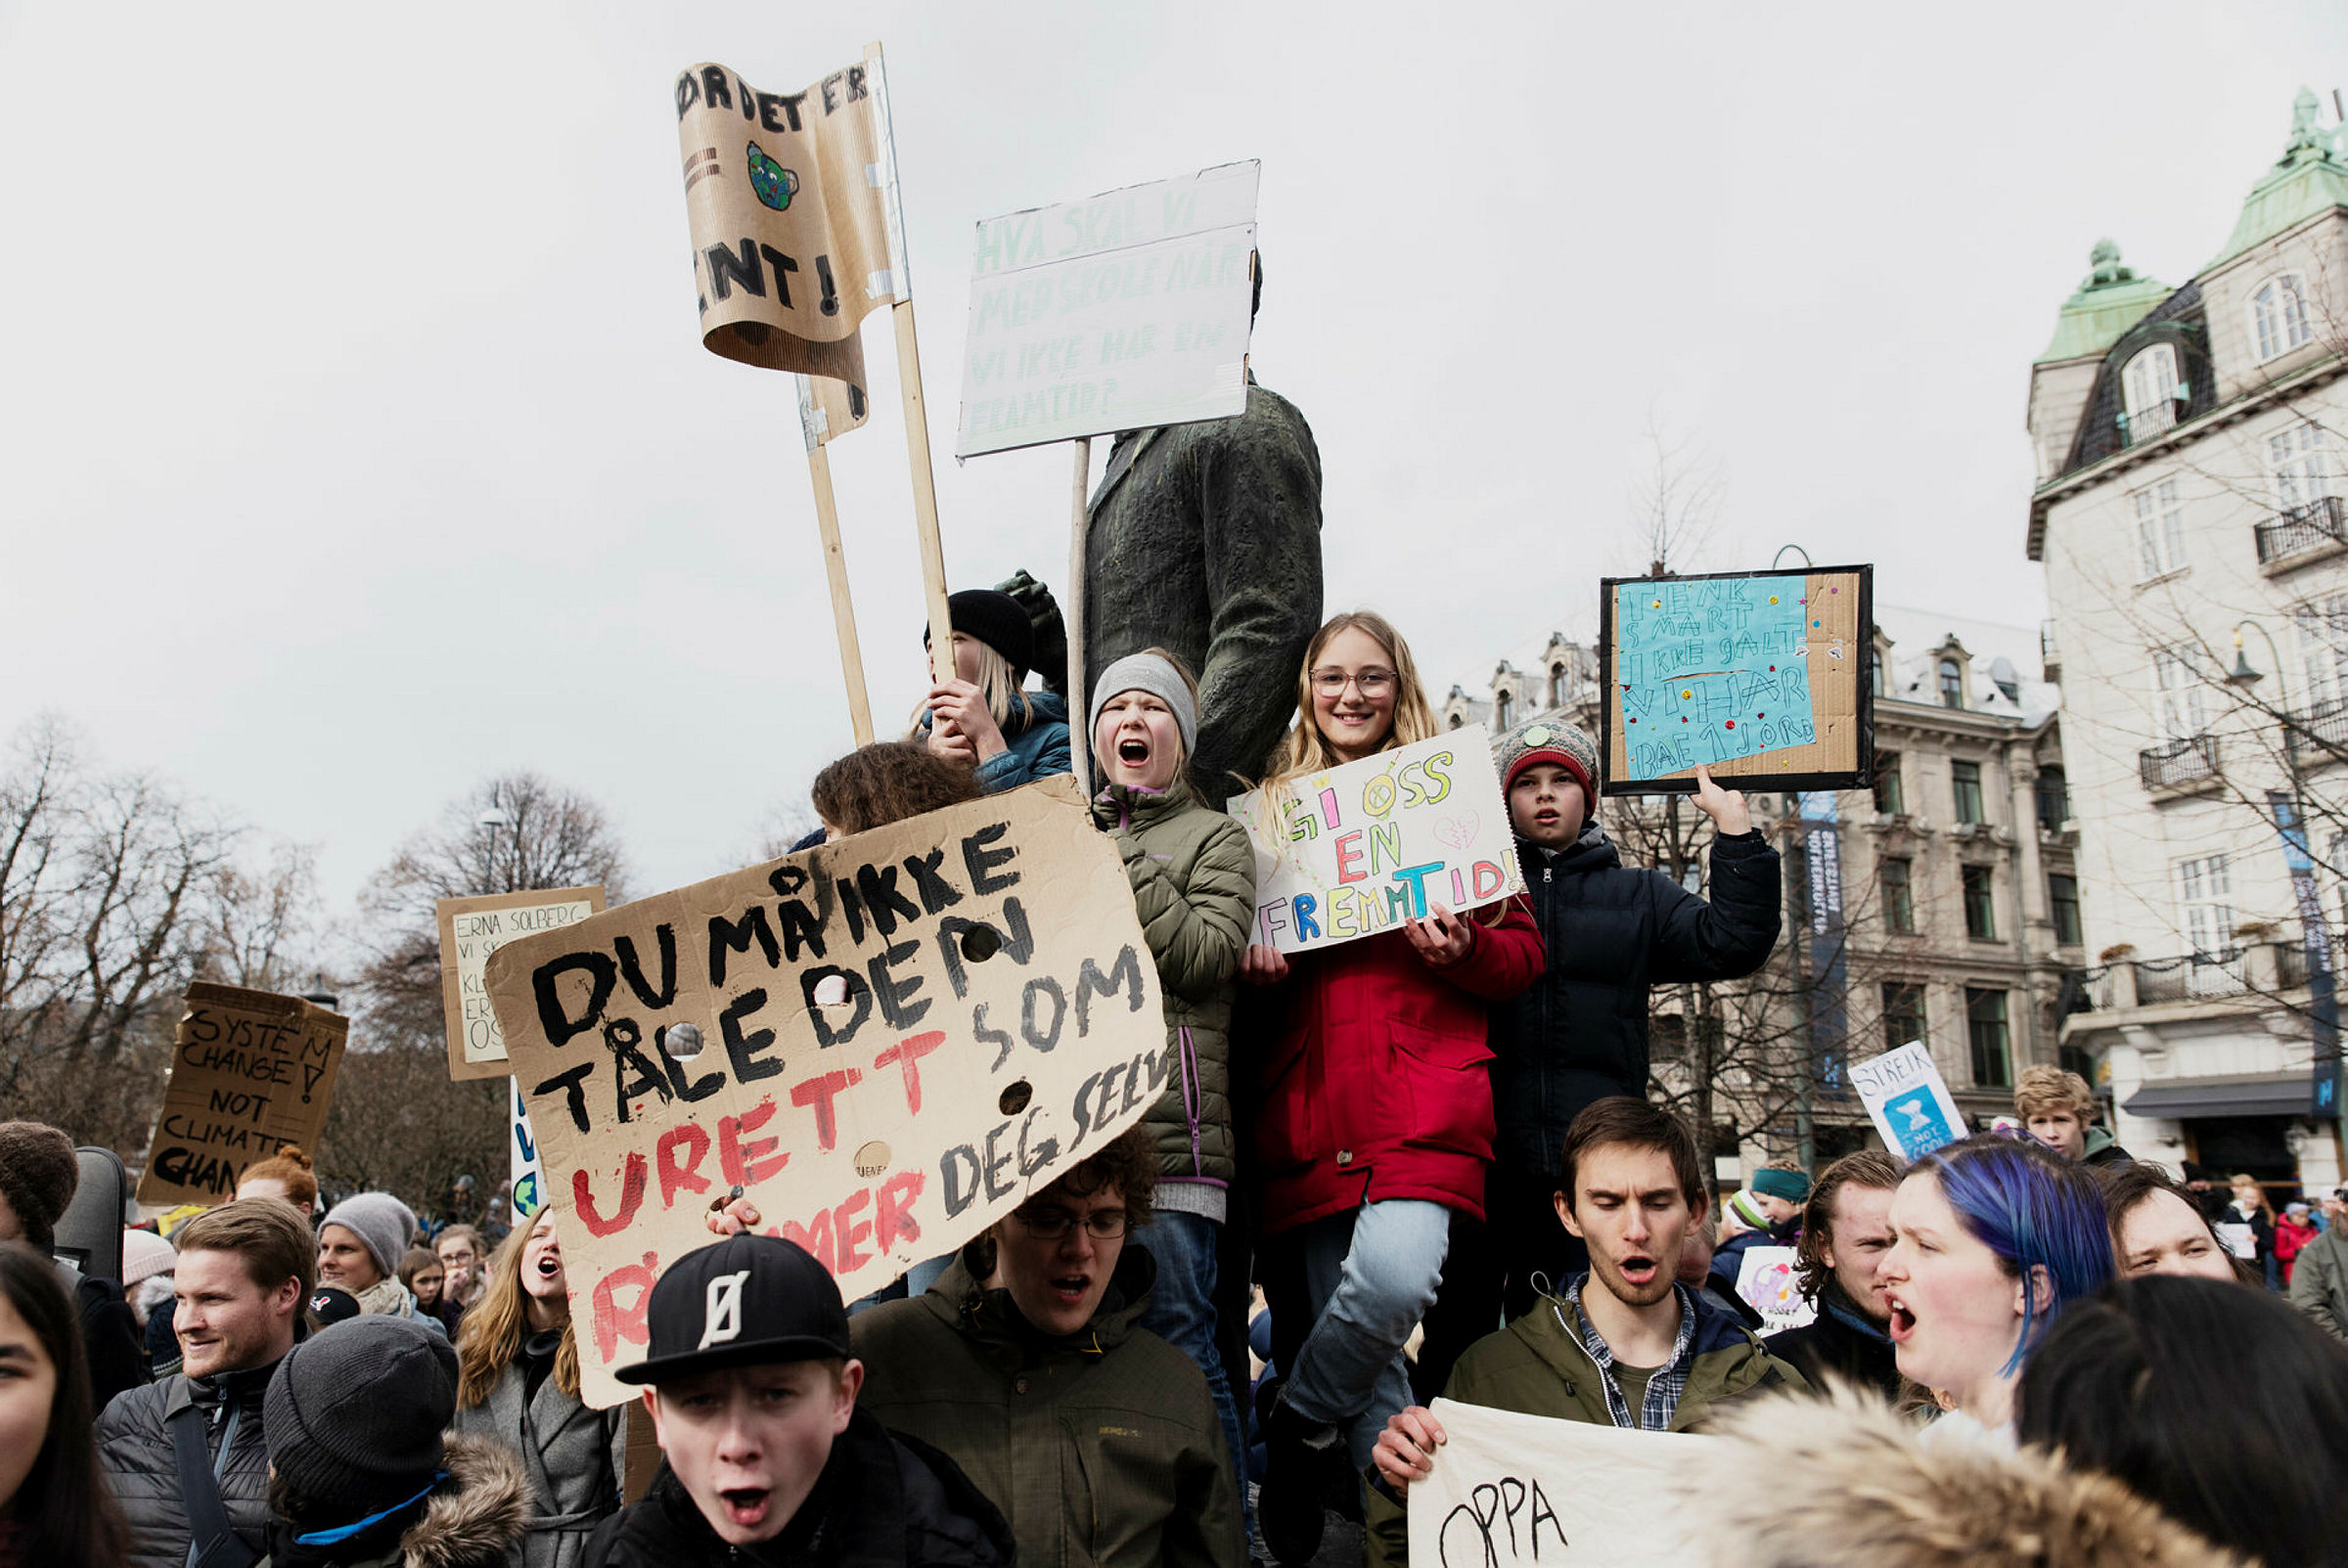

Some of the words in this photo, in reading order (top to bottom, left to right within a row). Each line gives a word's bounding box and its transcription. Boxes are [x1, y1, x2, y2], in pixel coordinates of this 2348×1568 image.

[736, 77, 807, 133] DET
[821, 65, 869, 117] ER
[1619, 578, 1748, 622] TENK
[1626, 602, 1754, 649] SMART
[1629, 638, 1704, 686] IKKE
[1625, 681, 1680, 717] VI
[1693, 666, 1806, 724] HAR
[1699, 722, 1728, 762] 1
[1737, 714, 1815, 755] JORD
[1282, 786, 1341, 841] GI
[1363, 751, 1454, 820] OSS
[1334, 822, 1401, 884] EN
[456, 914, 502, 938] ERNA
[510, 904, 585, 933] SOLBERG
[532, 922, 677, 1048] DU
[708, 866, 829, 989] MÅ
[835, 820, 1022, 949] IKKE
[459, 942, 474, 959] VI
[191, 1008, 333, 1069] SYSTEM
[532, 988, 786, 1135] TÅLE
[800, 896, 1034, 1051] DEN
[572, 1030, 946, 1238] URETT
[971, 944, 1146, 1074] SOM
[1854, 1049, 1933, 1097] STREIK
[208, 1088, 273, 1123] NOT
[939, 1105, 1061, 1221] DEG
